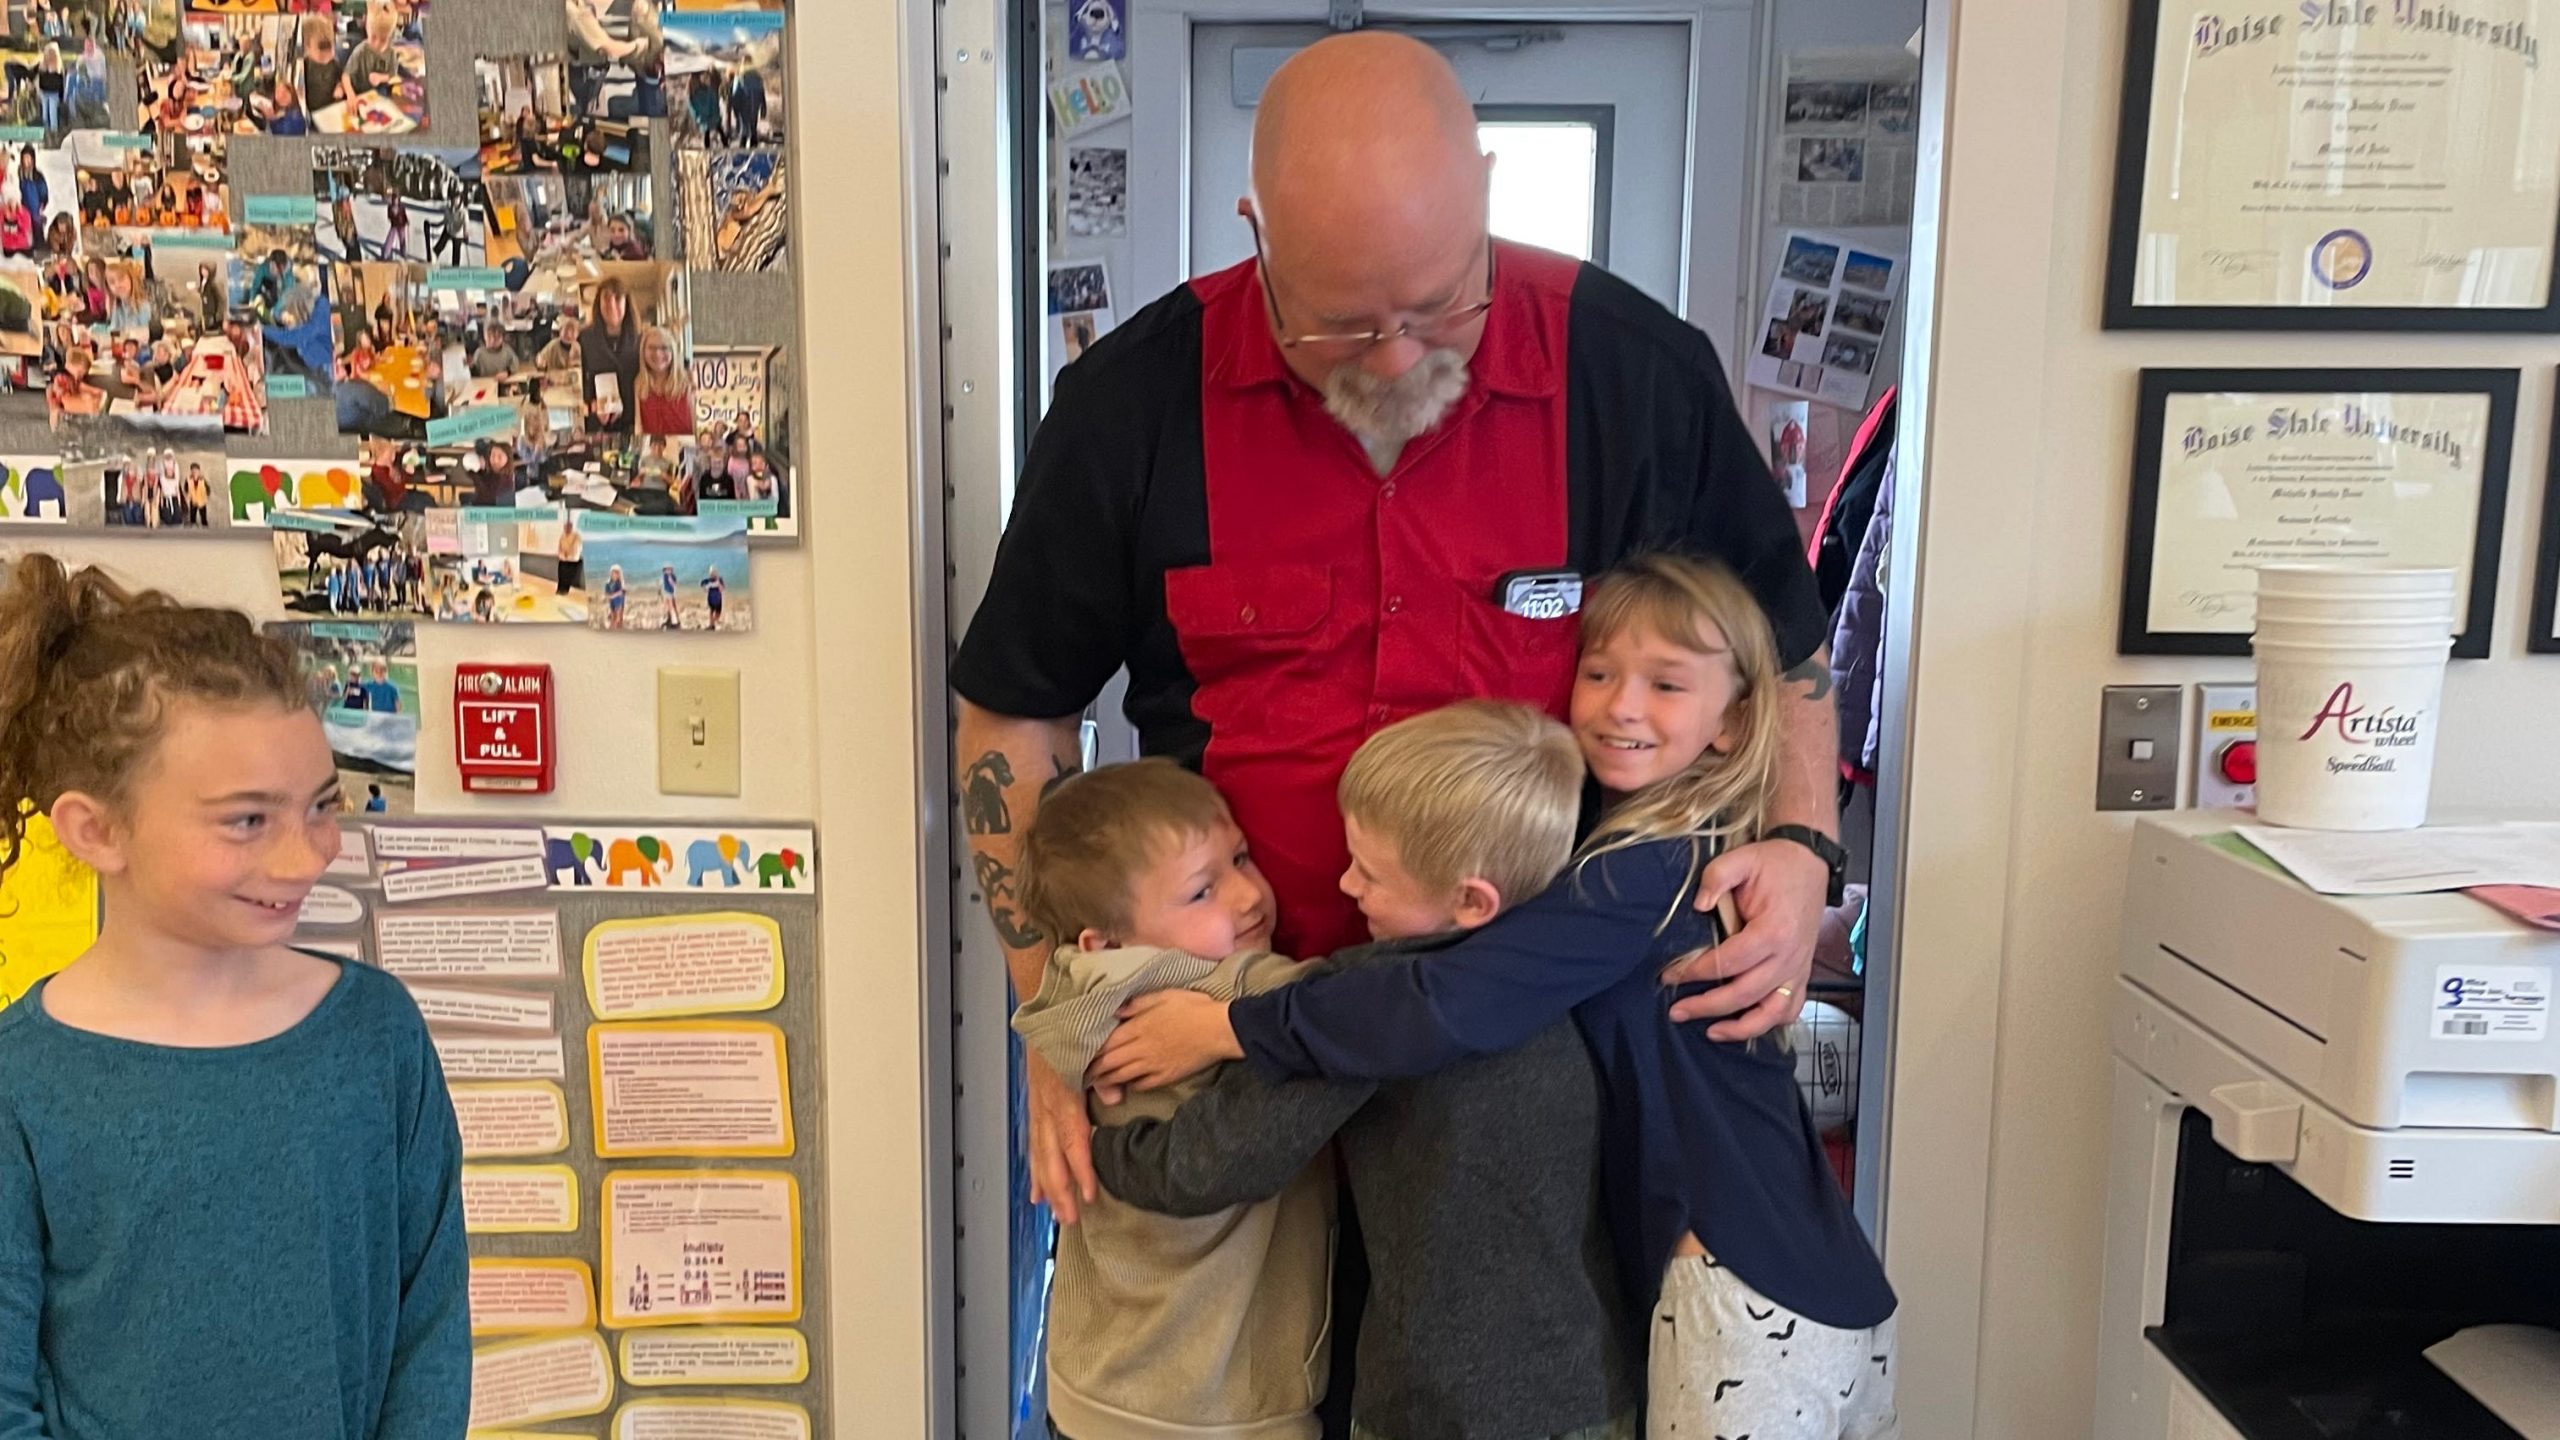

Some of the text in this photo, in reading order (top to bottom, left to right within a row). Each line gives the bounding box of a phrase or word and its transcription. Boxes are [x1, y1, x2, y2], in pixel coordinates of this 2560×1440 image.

[2195, 15, 2284, 53] Boise
[2394, 0, 2539, 70] University
[2182, 424, 2254, 458] Boise
[2267, 408, 2330, 438] State
[2343, 403, 2464, 468] University
[1521, 598, 1564, 619] 11:02
[504, 676, 540, 694] ALARM
[481, 709, 517, 724] LIFT
[2298, 681, 2421, 745] Artista
[494, 726, 506, 741] &
[2375, 729, 2417, 748] wheel
[480, 743, 522, 758] PULL
